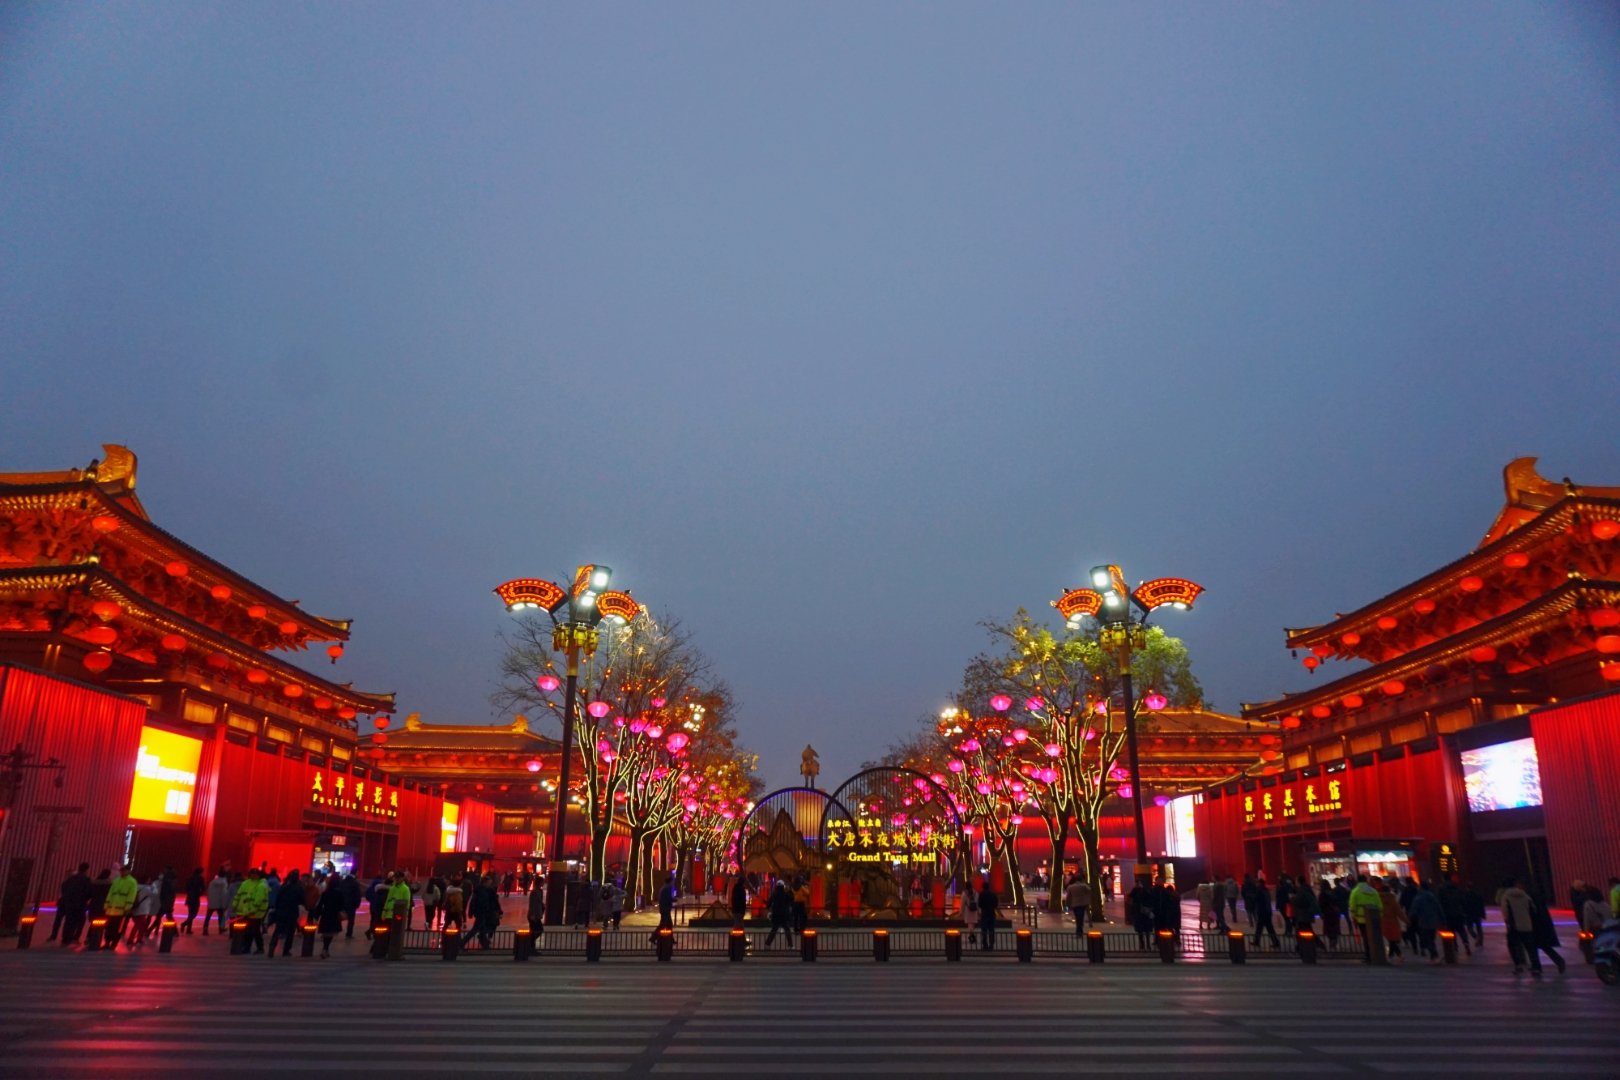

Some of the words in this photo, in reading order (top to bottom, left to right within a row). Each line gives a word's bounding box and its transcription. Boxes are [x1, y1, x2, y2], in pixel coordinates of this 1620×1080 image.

[826, 831, 956, 849] 大唐不夜城步行街
[848, 852, 881, 862] Grand
[883, 852, 909, 864] Tang
[912, 852, 936, 862] Mall
